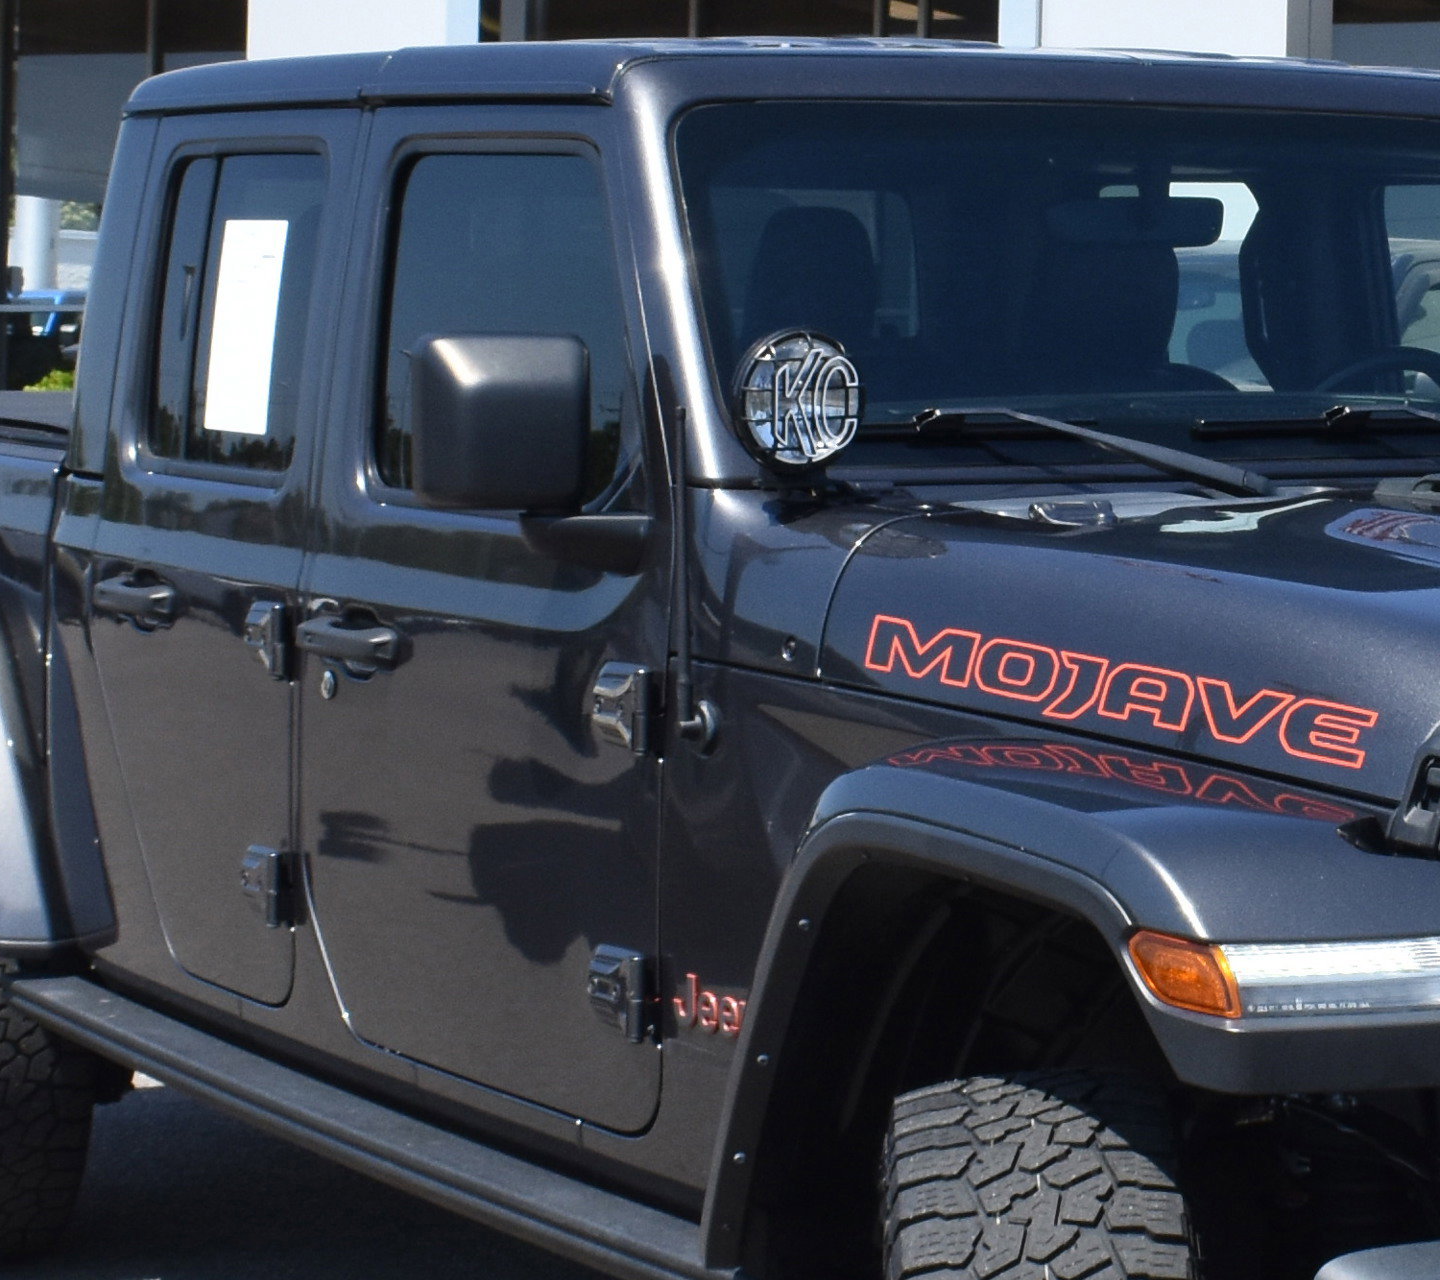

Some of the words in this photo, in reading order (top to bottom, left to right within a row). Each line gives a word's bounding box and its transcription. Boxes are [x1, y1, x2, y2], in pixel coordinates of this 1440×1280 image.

[774, 348, 859, 458] KC
[865, 614, 1379, 769] MOJAVE
[672, 971, 747, 1038] Jee
